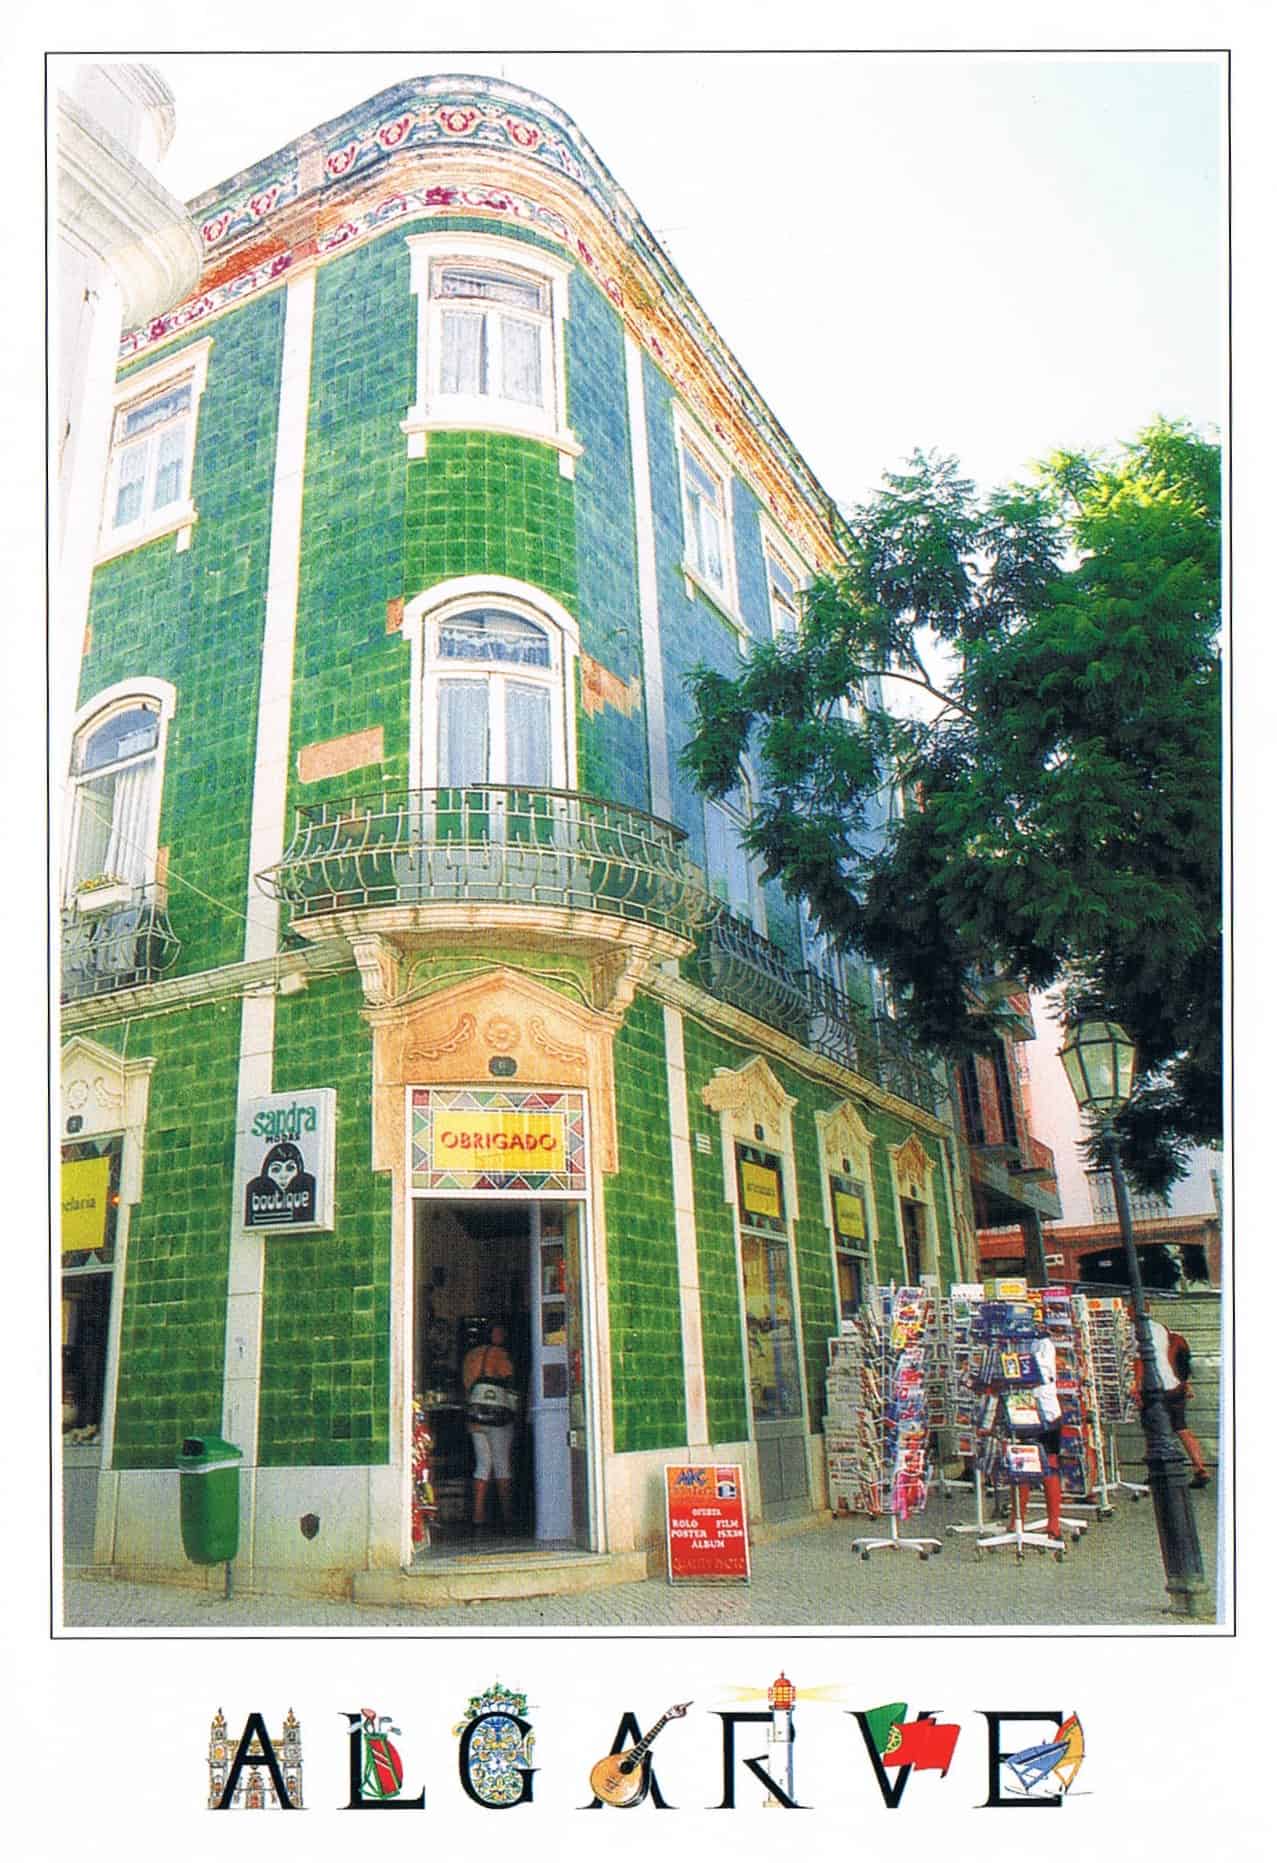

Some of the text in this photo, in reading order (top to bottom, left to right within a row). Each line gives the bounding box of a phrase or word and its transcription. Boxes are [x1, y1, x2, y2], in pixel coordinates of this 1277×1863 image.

[251, 1102, 317, 1136] sandra
[265, 1133, 301, 1144] MODAS
[440, 1131, 557, 1151] OBRIGADO
[252, 1190, 310, 1211] boutique
[671, 1529, 707, 1539] POSTER
[691, 1540, 725, 1550] ALBUM
